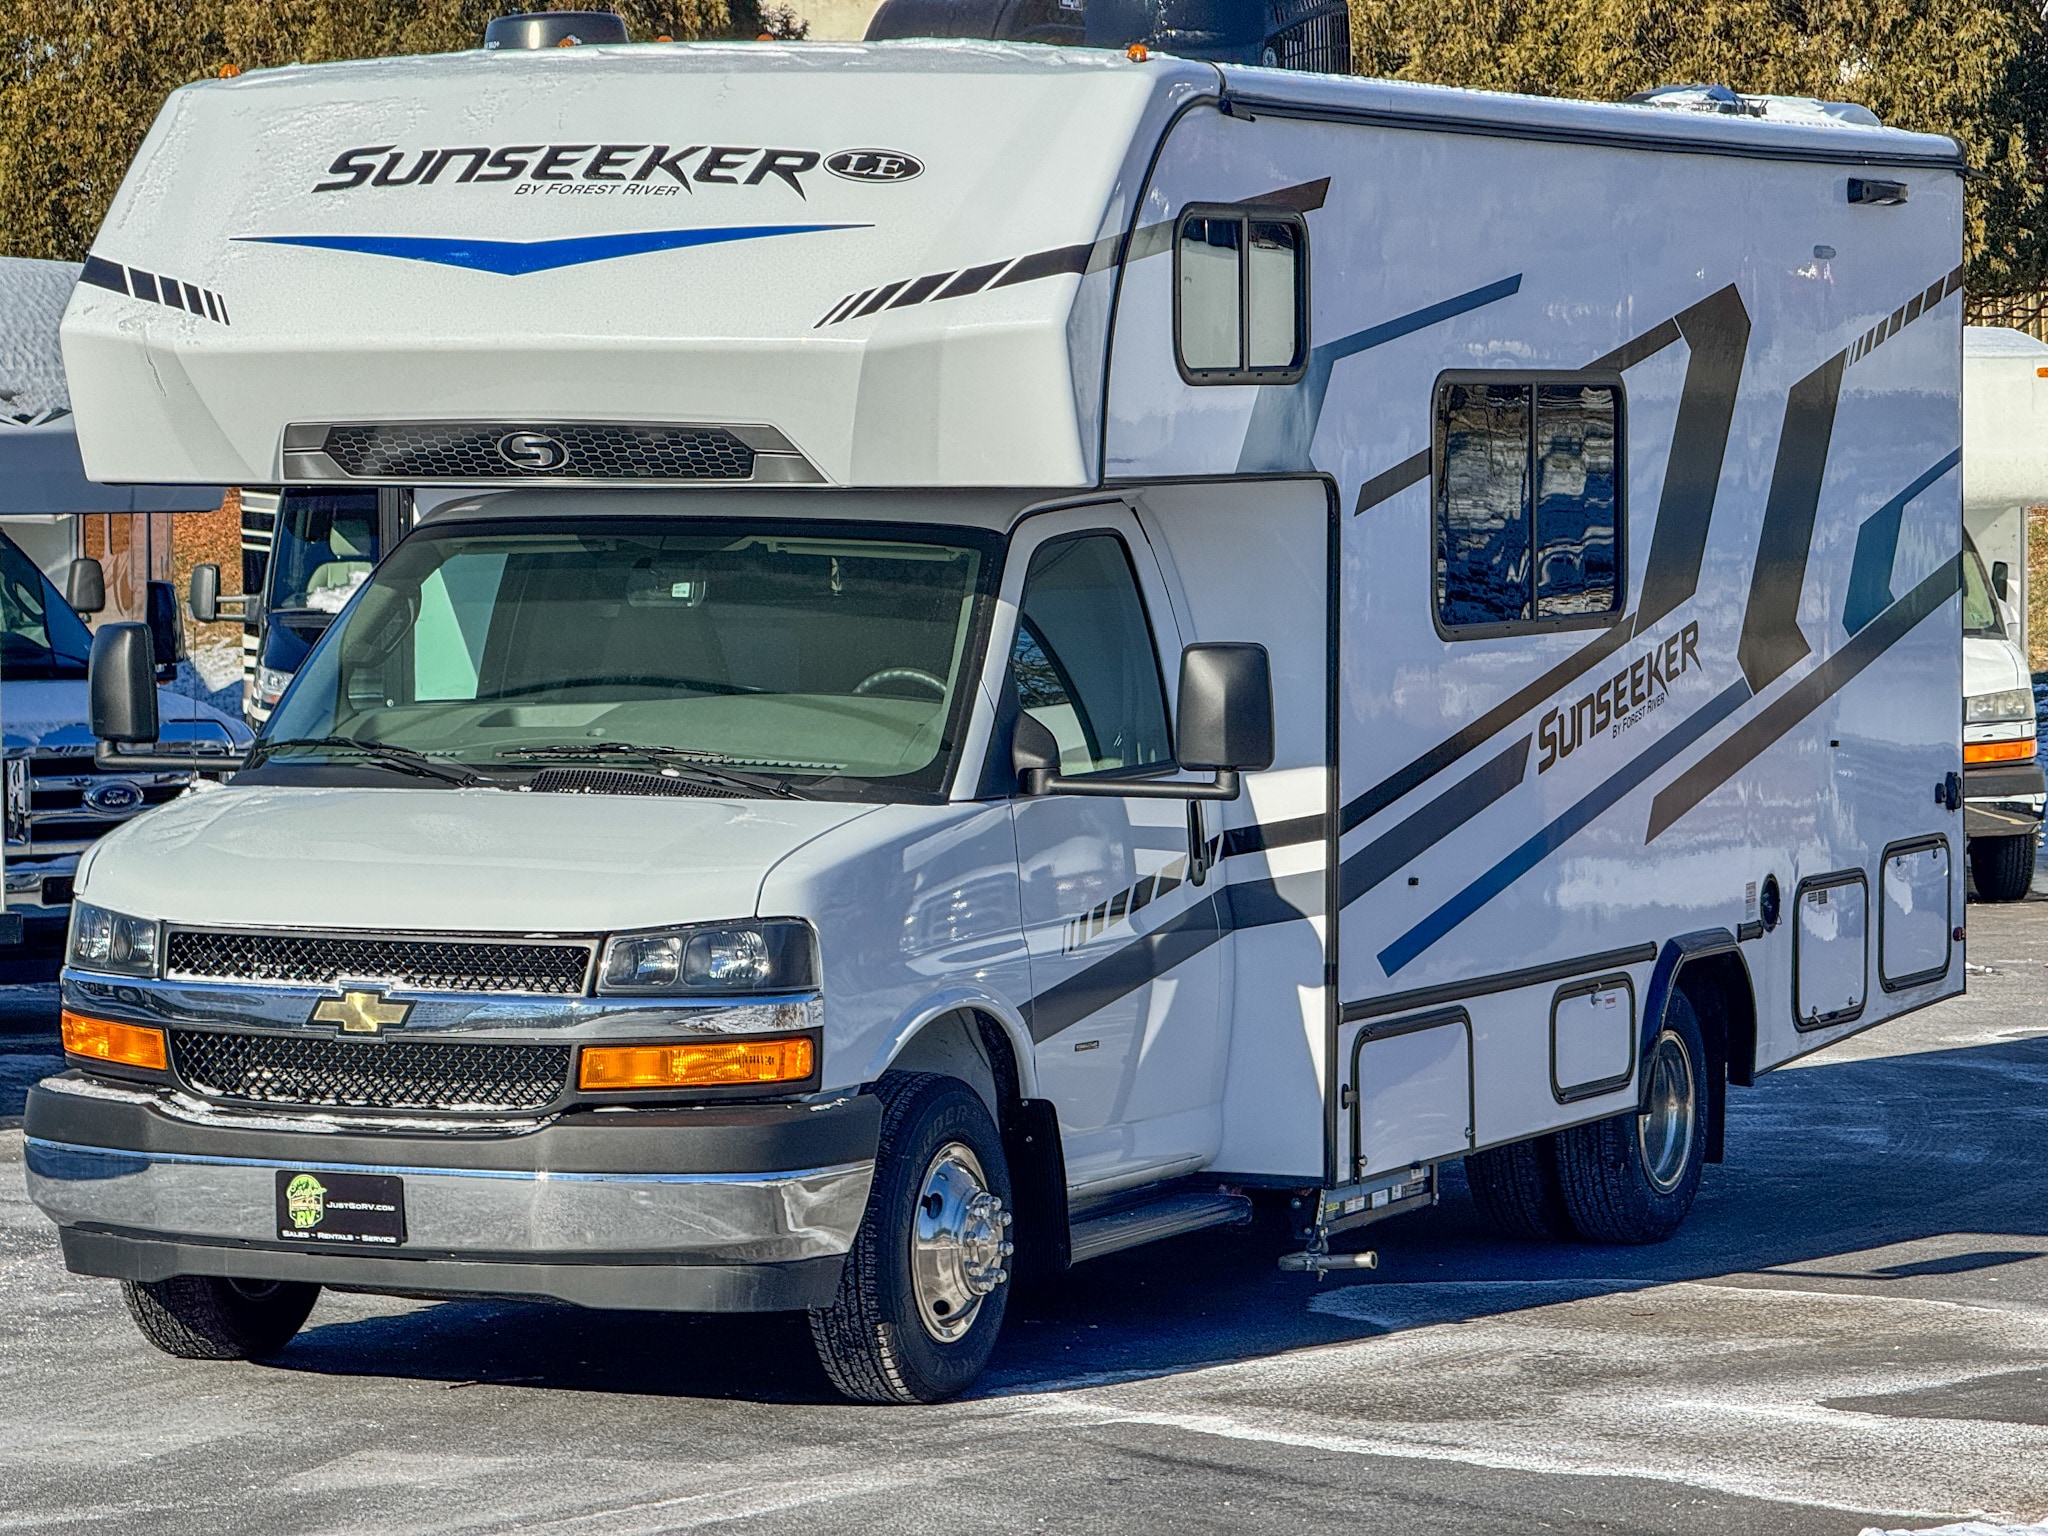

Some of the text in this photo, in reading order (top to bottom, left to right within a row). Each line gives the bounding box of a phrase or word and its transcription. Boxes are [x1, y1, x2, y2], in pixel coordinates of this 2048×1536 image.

[840, 153, 906, 178] LE
[514, 183, 681, 196] BY FOREST RIVER
[510, 435, 553, 467] S
[1612, 692, 1665, 739] BY FOREST RIVER
[104, 790, 131, 805] Ford
[296, 1210, 317, 1227] RV
[282, 1230, 310, 1239] SALES
[317, 1231, 354, 1241] RENTALS
[361, 1234, 397, 1243] SERVICE
